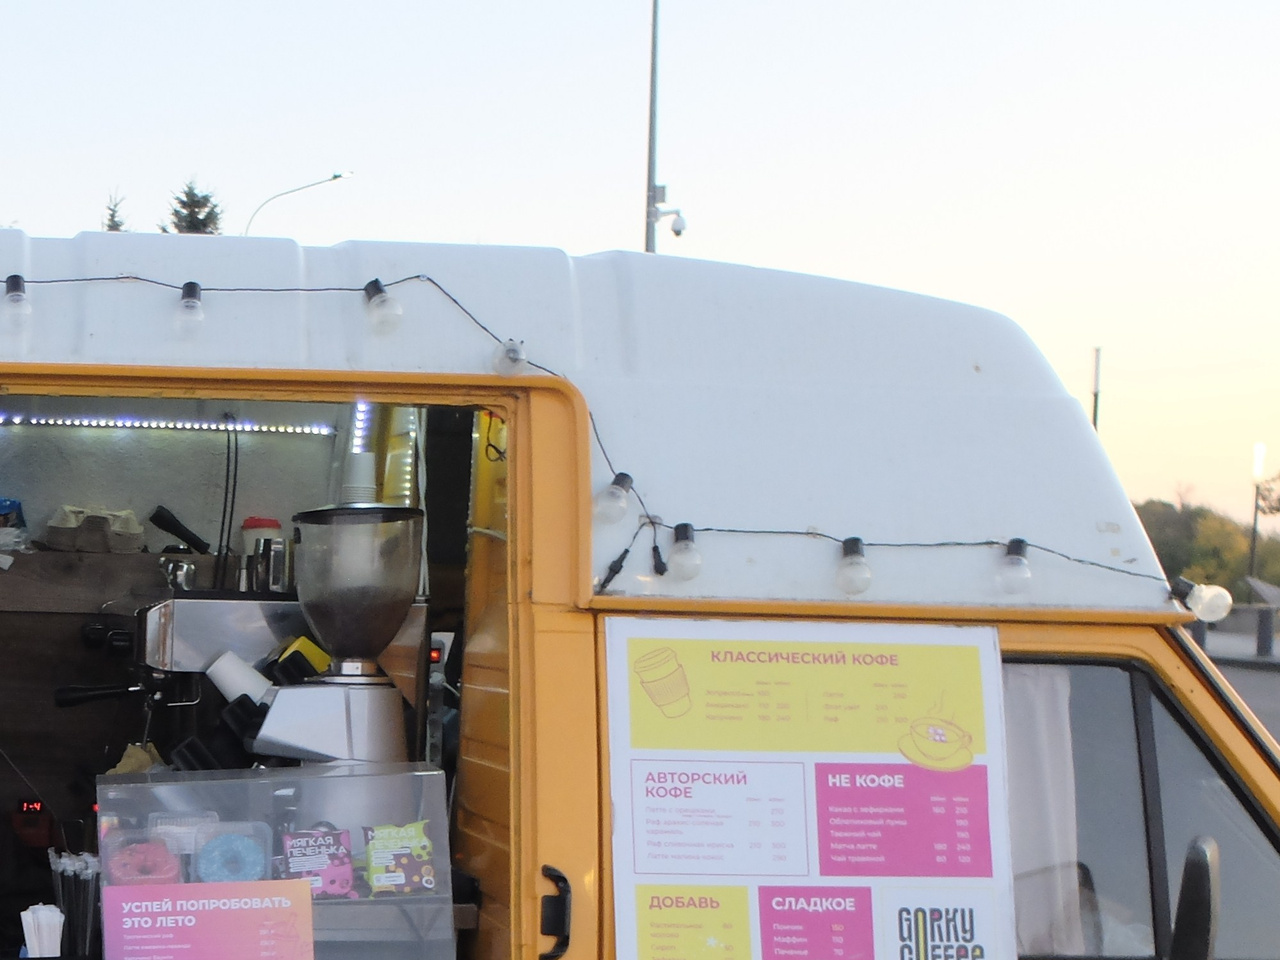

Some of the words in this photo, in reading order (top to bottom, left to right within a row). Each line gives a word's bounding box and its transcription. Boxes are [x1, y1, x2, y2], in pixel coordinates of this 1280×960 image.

[710, 650, 847, 665] КЛАССИЧЕСКИЙ
[852, 652, 900, 667] КОФЕ
[644, 770, 748, 785] АВТОРСКИЙ
[827, 774, 851, 787] НЕ
[855, 774, 905, 788] КОФЕ
[645, 786, 693, 799] КОФЕ
[368, 827, 415, 840] МЯГКАЯ
[287, 836, 334, 848] МЯГКАЯ
[287, 846, 348, 858] ПЕЧЕНЬКА
[122, 898, 173, 914] УСПЕЙ
[176, 896, 292, 912] ПОПРОБОВАТЬ
[648, 896, 721, 910] ДОБАВЬ
[771, 897, 856, 912] СЛАДКОЕ
[122, 916, 153, 929] ЭТО
[155, 915, 197, 929] ЛЕТО
[898, 907, 975, 943] GORKY
